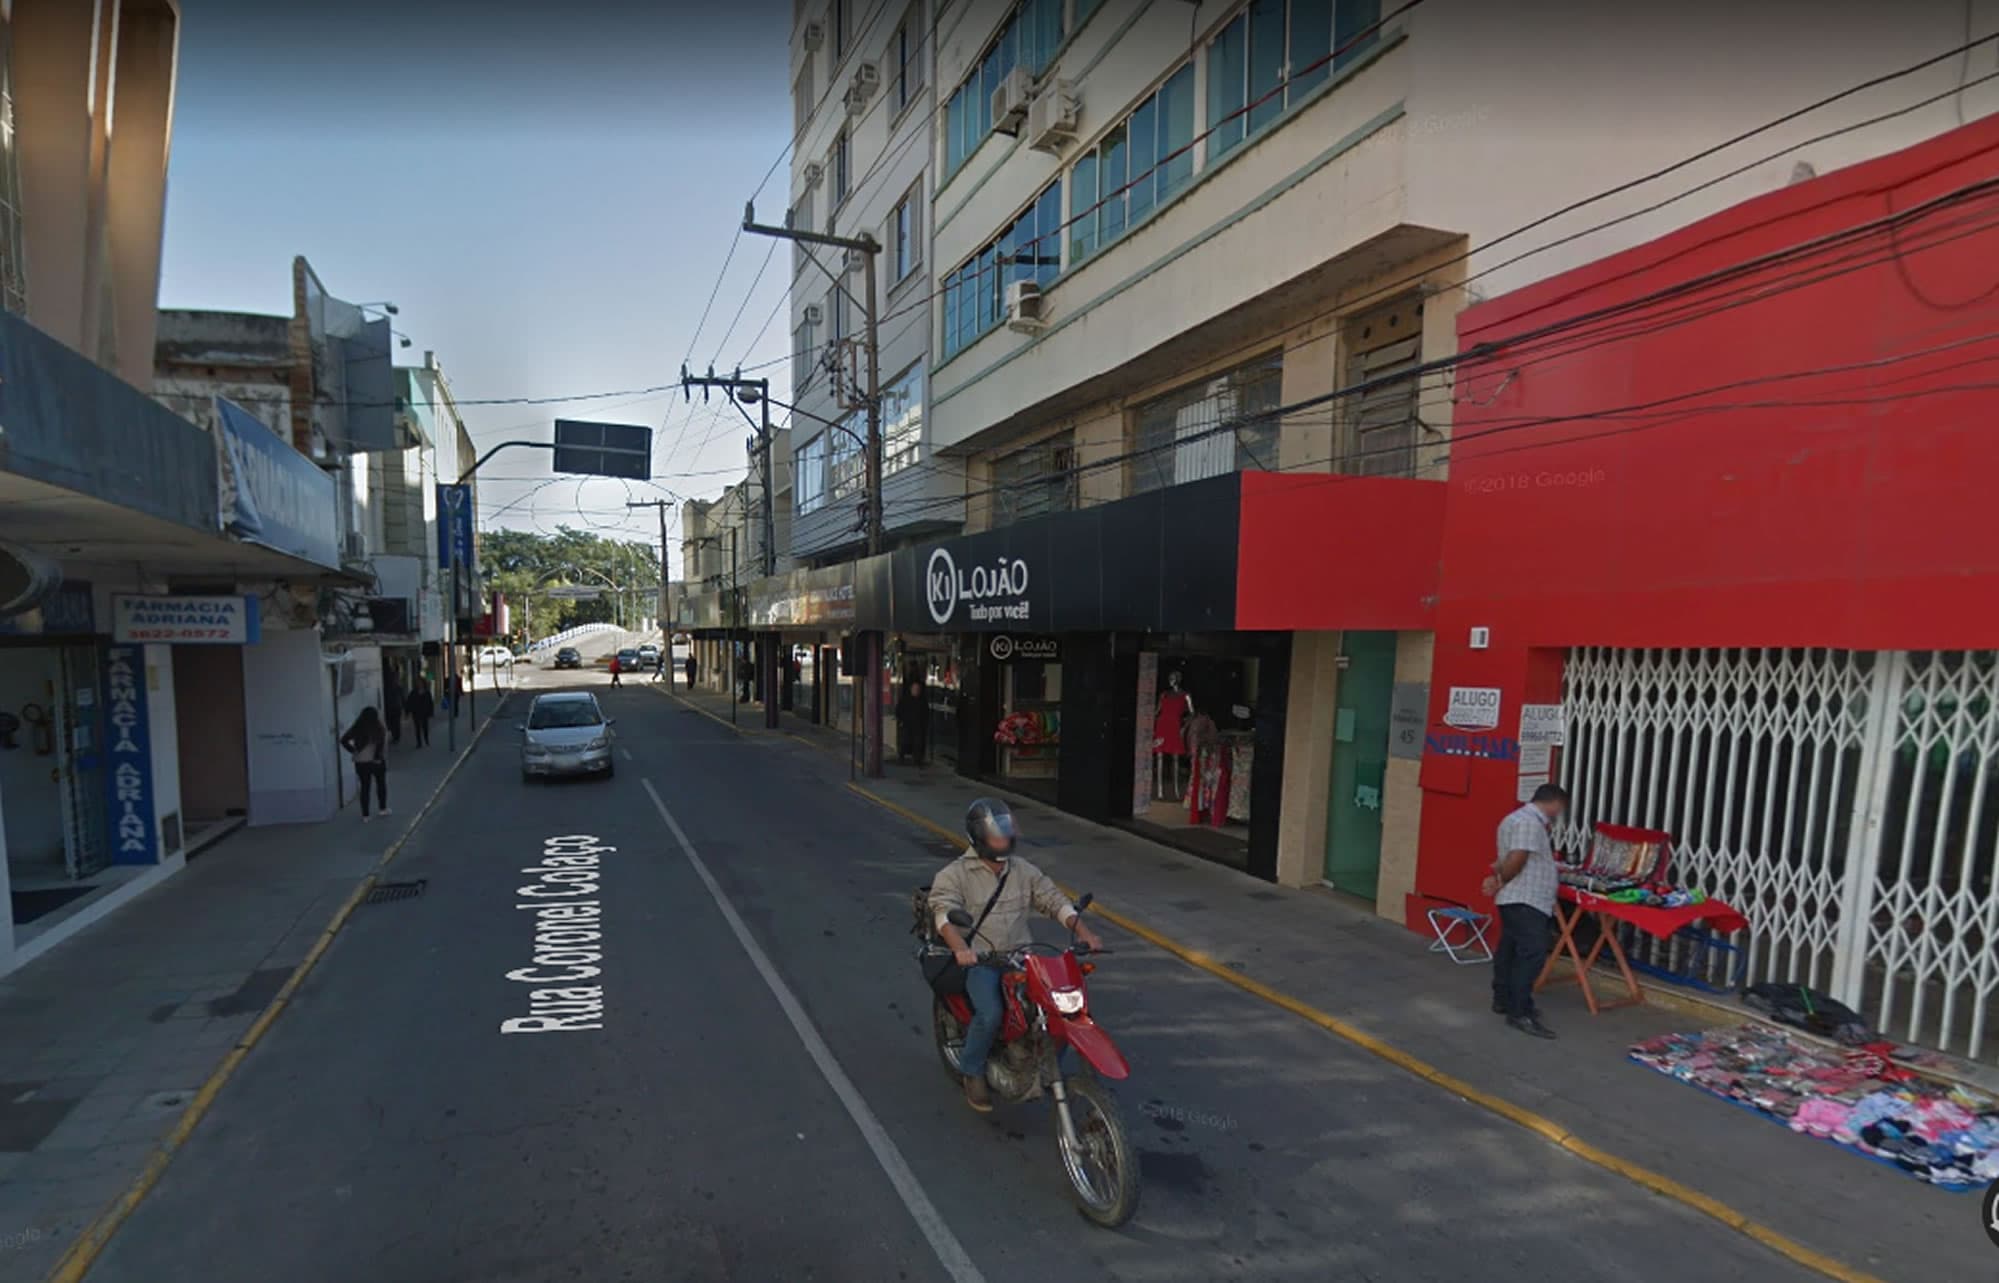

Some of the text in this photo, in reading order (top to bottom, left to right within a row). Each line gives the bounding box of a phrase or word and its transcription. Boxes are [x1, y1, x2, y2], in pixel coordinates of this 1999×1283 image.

[958, 556, 1028, 600] LOJÃO
[131, 614, 230, 625] ADRIANA
[1452, 691, 1497, 707] ALUGO
[1401, 729, 1415, 745] 45
[109, 648, 146, 852] FARMACIA ADRIANA
